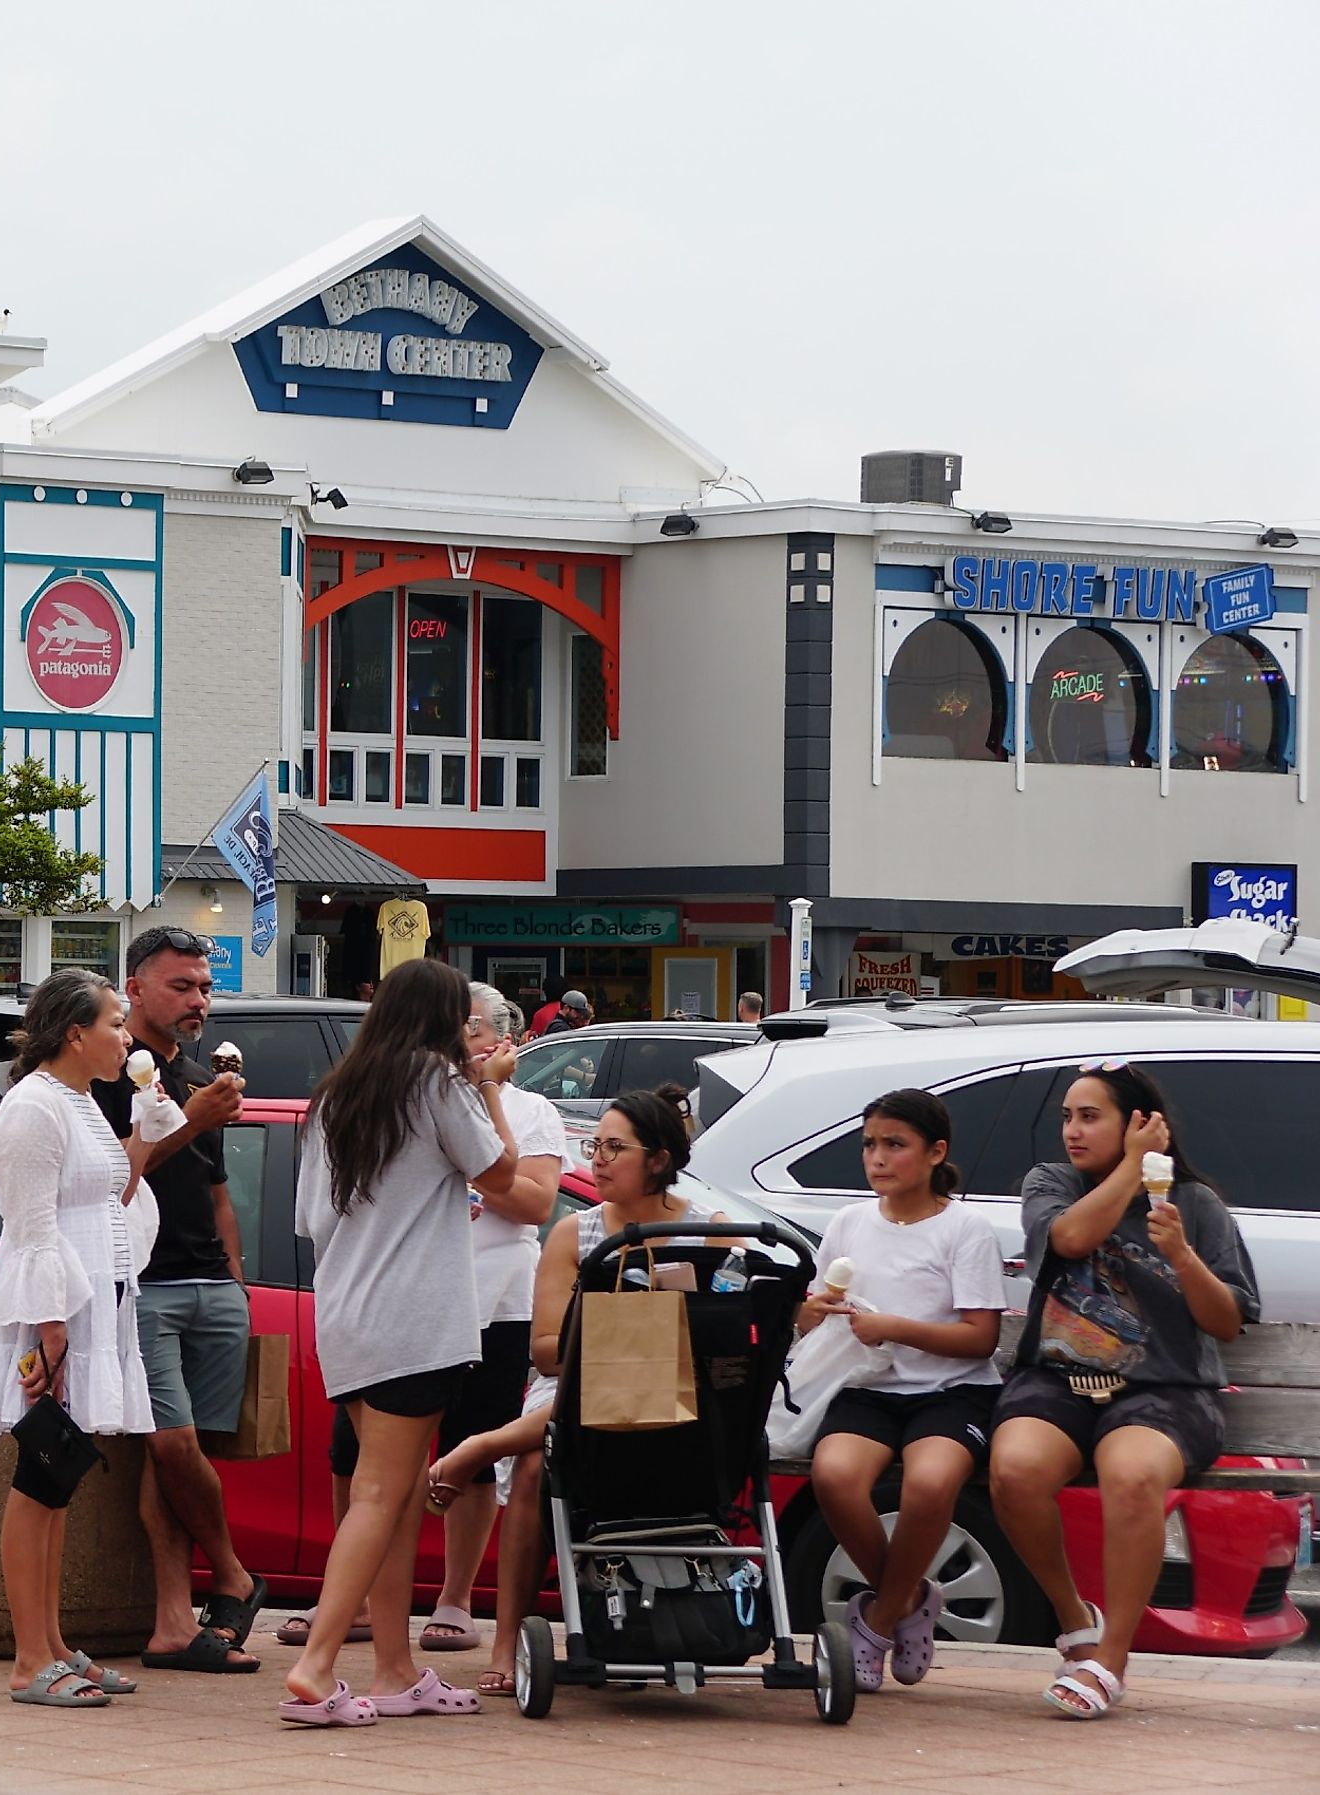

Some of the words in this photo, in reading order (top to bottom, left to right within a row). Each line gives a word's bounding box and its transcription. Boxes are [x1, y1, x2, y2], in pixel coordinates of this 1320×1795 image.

[320, 269, 479, 335] BETHANY
[277, 324, 382, 371] TOWN
[386, 334, 513, 382] CENTER
[952, 555, 1098, 616] SHORE
[1112, 565, 1197, 622] FUN
[1222, 575, 1255, 594] FAMILY
[1230, 591, 1250, 606] FUN
[1222, 603, 1260, 623] CENTER
[409, 619, 447, 638] OPEN
[39, 660, 112, 679] patagonia
[1050, 673, 1104, 700] ARCADE
[1227, 875, 1288, 909] Sugar
[448, 909, 507, 936] Three
[513, 911, 585, 936] Blonde
[591, 911, 662, 936] Bakers
[951, 935, 1069, 957] CAKES
[858, 953, 912, 975] FRESH
